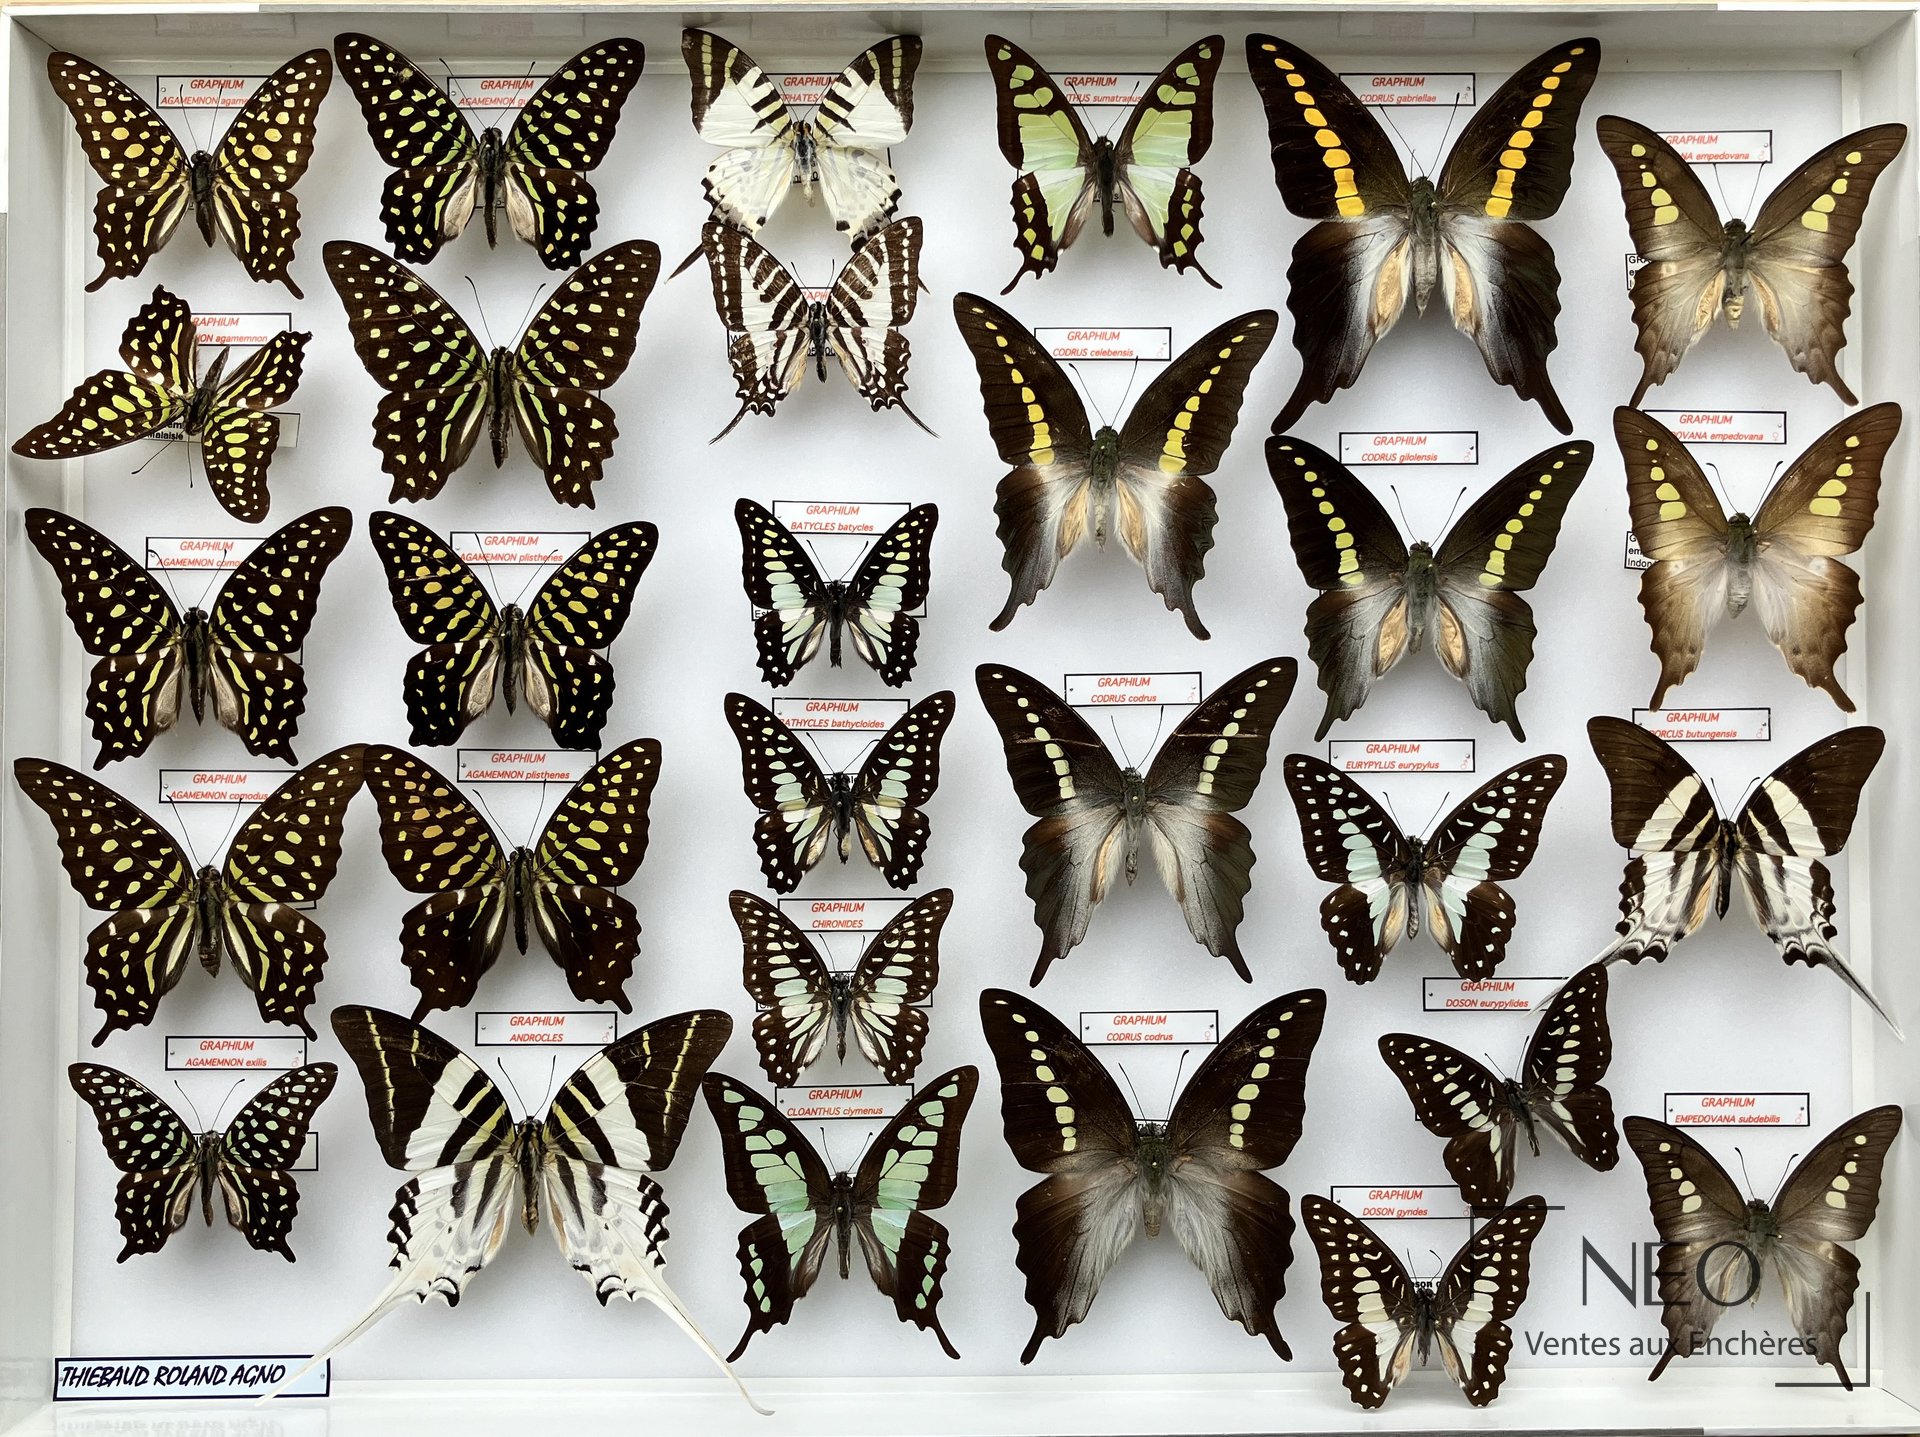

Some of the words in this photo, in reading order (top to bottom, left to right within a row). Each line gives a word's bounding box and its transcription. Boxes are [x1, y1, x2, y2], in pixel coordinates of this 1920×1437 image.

[189, 80, 245, 89] GRAPHIUM
[480, 80, 534, 90] GRAPHIUM
[1063, 77, 1117, 86] GRAPHIUM
[1371, 77, 1425, 86] GRAPHIUM
[160, 96, 220, 105] AGAMEMNON
[458, 97, 517, 106] AGAMEMNON
[1359, 94, 1395, 102] CODRUS
[1396, 94, 1438, 104] gabriellae
[1665, 135, 1719, 144] GRAPHIUM
[1695, 152, 1750, 161] empedovana
[192, 318, 240, 327] RAPHIUM
[215, 335, 269, 343] agamemnon
[1066, 331, 1121, 341] GRAPHIUM
[1052, 348, 1088, 356] CODRUS
[1089, 348, 1134, 356] celebensis
[1678, 415, 1733, 424] GRAPHIUM
[1373, 436, 1428, 446] GRAPHIUM
[1710, 432, 1764, 441] empedovana
[1361, 453, 1397, 461] CODRUS
[1398, 452, 1439, 463] gilolensis
[805, 506, 860, 515] GRAPHIUM
[790, 522, 837, 530] BATYCLES
[837, 523, 874, 533] batycles
[179, 541, 235, 550] GRAPHIUM
[484, 536, 539, 546] GRAPHIUM
[156, 558, 219, 567] AGAMEMNON
[459, 553, 518, 561] AGAMEMNON
[518, 553, 564, 563] plisthenes
[1097, 678, 1151, 687] GRAPHIUM
[1090, 694, 1127, 703] CODRUS
[1127, 694, 1157, 702] codrus
[805, 703, 859, 712] GRAPHIUM
[1666, 713, 1720, 722] GRAPHIUM
[831, 719, 885, 729] bathycloides
[1685, 729, 1738, 739] butungensis
[1365, 744, 1421, 753] GRAPHIUM
[490, 754, 546, 763] GRAPHIUM
[1345, 760, 1397, 769] EURYPYLUS
[1397, 760, 1440, 770] eurypylus
[192, 775, 247, 784] GRAPHIUM
[465, 770, 524, 779] AGAMEMNON
[525, 770, 571, 780] plisthenes
[169, 791, 228, 799] AGAMEMNON
[229, 791, 269, 799] comodus
[810, 903, 865, 912] GRAPHIUM
[811, 919, 864, 928] CHIRONIDES
[1460, 982, 1515, 991] GRAPHIUM
[1445, 999, 1479, 1007] DOSON
[1479, 999, 1529, 1009] eurypylides
[509, 1016, 565, 1026] GRAPHIUM
[1113, 1016, 1167, 1025] GRAPHIUM
[509, 1033, 564, 1042] ANDROCLES
[1106, 1032, 1143, 1041] CODRUS
[1144, 1032, 1173, 1041] codrus
[199, 1041, 255, 1050] GRAPHIUM
[185, 1058, 244, 1067] AGAMEMNON
[245, 1058, 268, 1066] exilis
[807, 1090, 863, 1099] GRAPHIUM
[1701, 1098, 1755, 1107] GRAPHIUM
[786, 1107, 841, 1116] CLOANTHUS
[842, 1107, 884, 1116] clymenus
[1674, 1114, 1737, 1123] EMPEDOVANA
[1738, 1114, 1781, 1123] subdebilis
[1368, 1190, 1423, 1200] GRAPHIUM
[1362, 1207, 1396, 1216] DOSON
[1395, 1207, 1428, 1217] gyndes
[62, 1366, 150, 1388] THIEBAUD
[153, 1365, 227, 1387] ROLAND
[229, 1364, 286, 1387] AGNO
